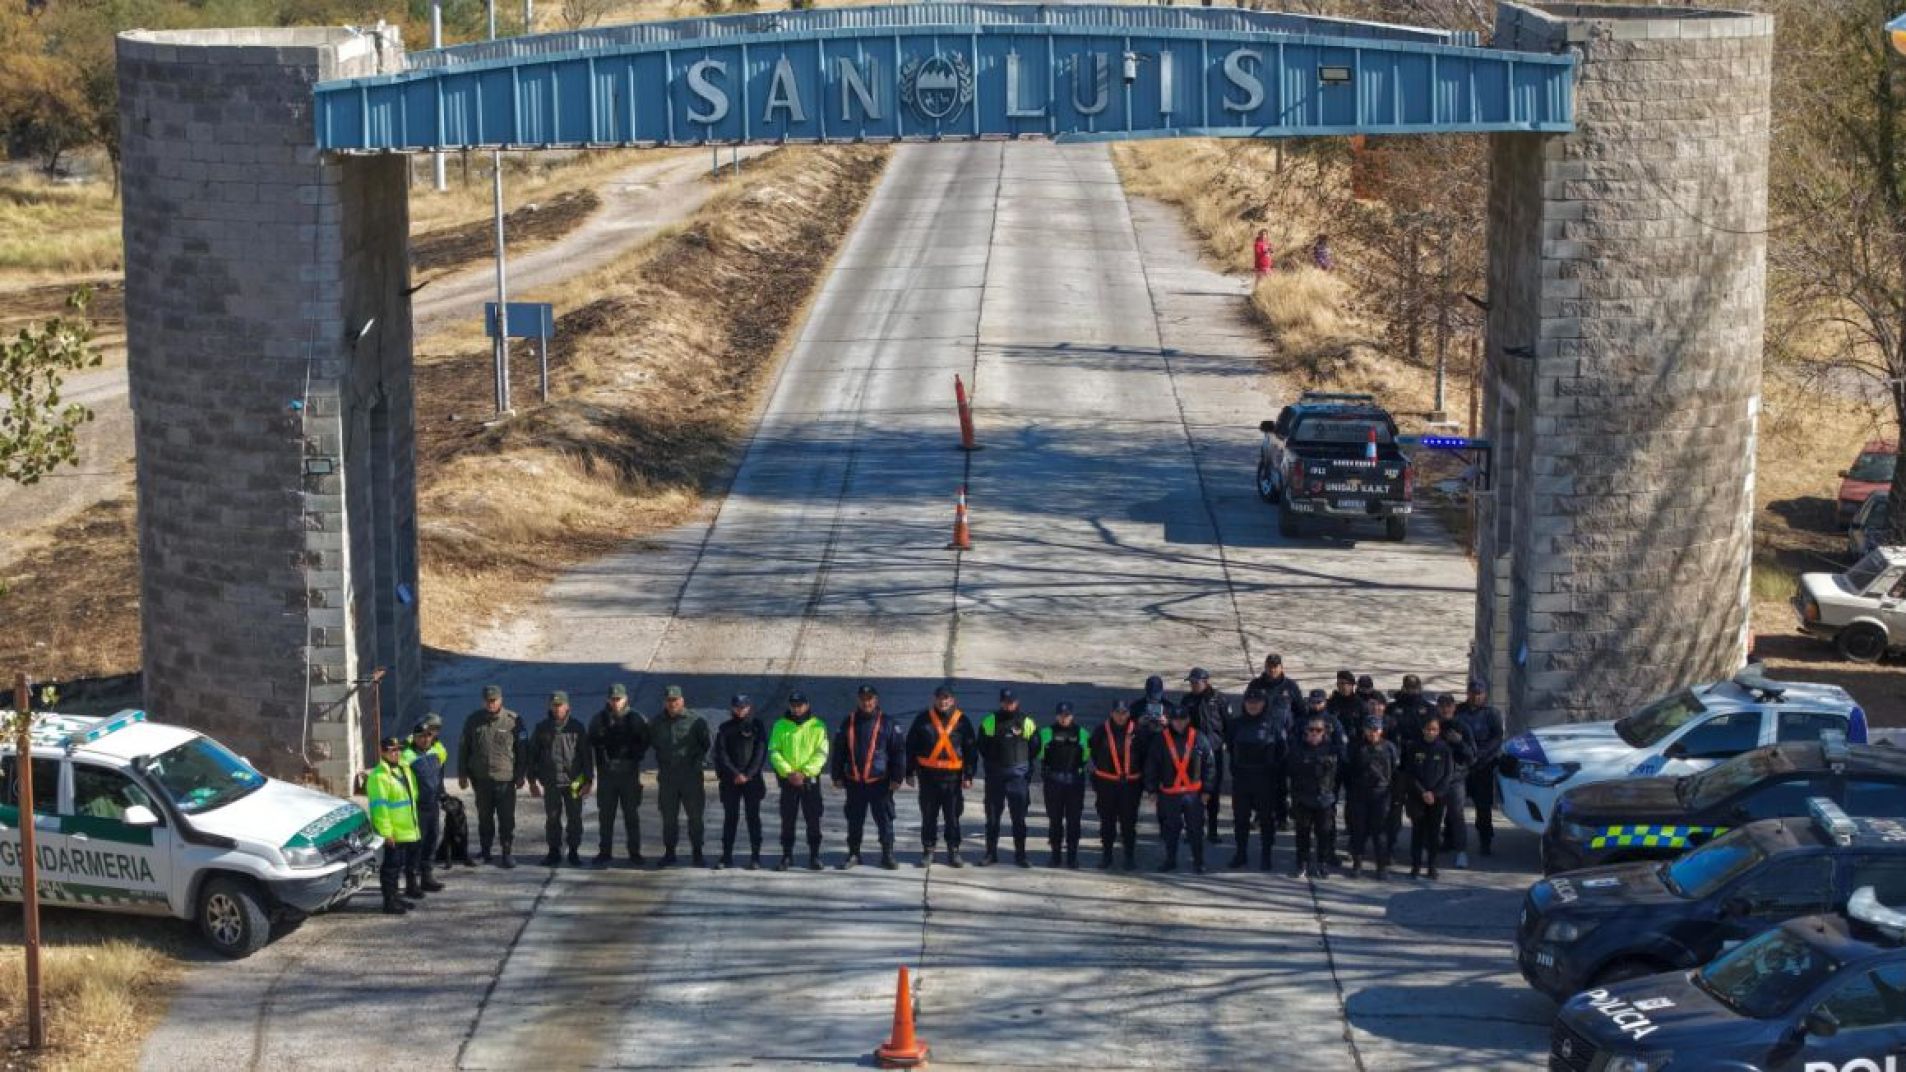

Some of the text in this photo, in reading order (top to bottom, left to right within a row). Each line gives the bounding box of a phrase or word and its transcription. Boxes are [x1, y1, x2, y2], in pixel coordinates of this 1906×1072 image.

[686, 49, 1265, 124] SAN LUIS
[1588, 988, 1660, 1041] POLICIA
